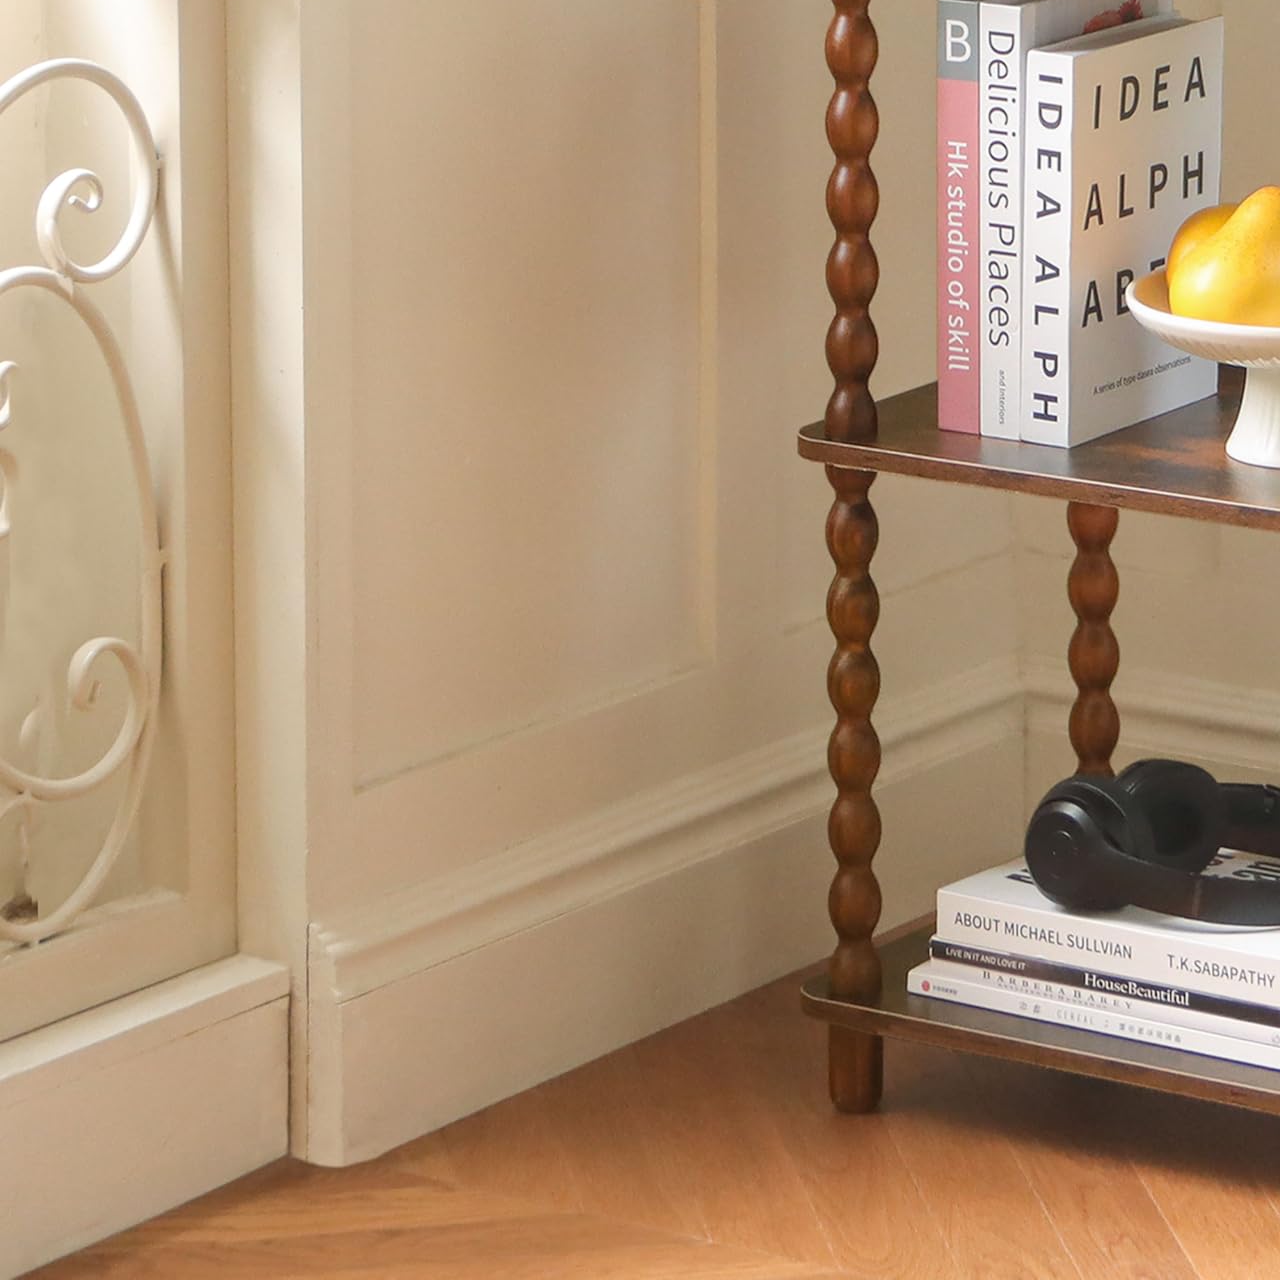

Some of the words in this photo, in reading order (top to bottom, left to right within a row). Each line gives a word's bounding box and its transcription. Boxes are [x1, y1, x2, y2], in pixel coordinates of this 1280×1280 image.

[945, 19, 972, 62] B
[988, 30, 1017, 209] Delicious
[1094, 56, 1206, 130] IDEA
[947, 140, 969, 178] Hk
[1036, 73, 1063, 219] IDEA
[1083, 151, 1204, 231] ALPH
[947, 185, 969, 273] studio
[947, 281, 970, 311] of
[988, 222, 1018, 347] Places
[1082, 257, 1166, 328] AB
[947, 315, 970, 371] skill
[1033, 254, 1061, 423] ALPH
[945, 947, 962, 958] LIVE
[963, 950, 972, 960] IN
[972, 951, 980, 961] IT
[979, 953, 996, 965] AND
[997, 956, 1018, 970] LOVE
[1018, 961, 1026, 970] IT
[954, 912, 1001, 932] ABOUT
[1004, 921, 1063, 946] MICHAEL
[1066, 934, 1133, 959] SULLVIAN
[1166, 953, 1276, 989] T.K.SABAPATHY
[1083, 972, 1190, 1007] HouseBeautiful
